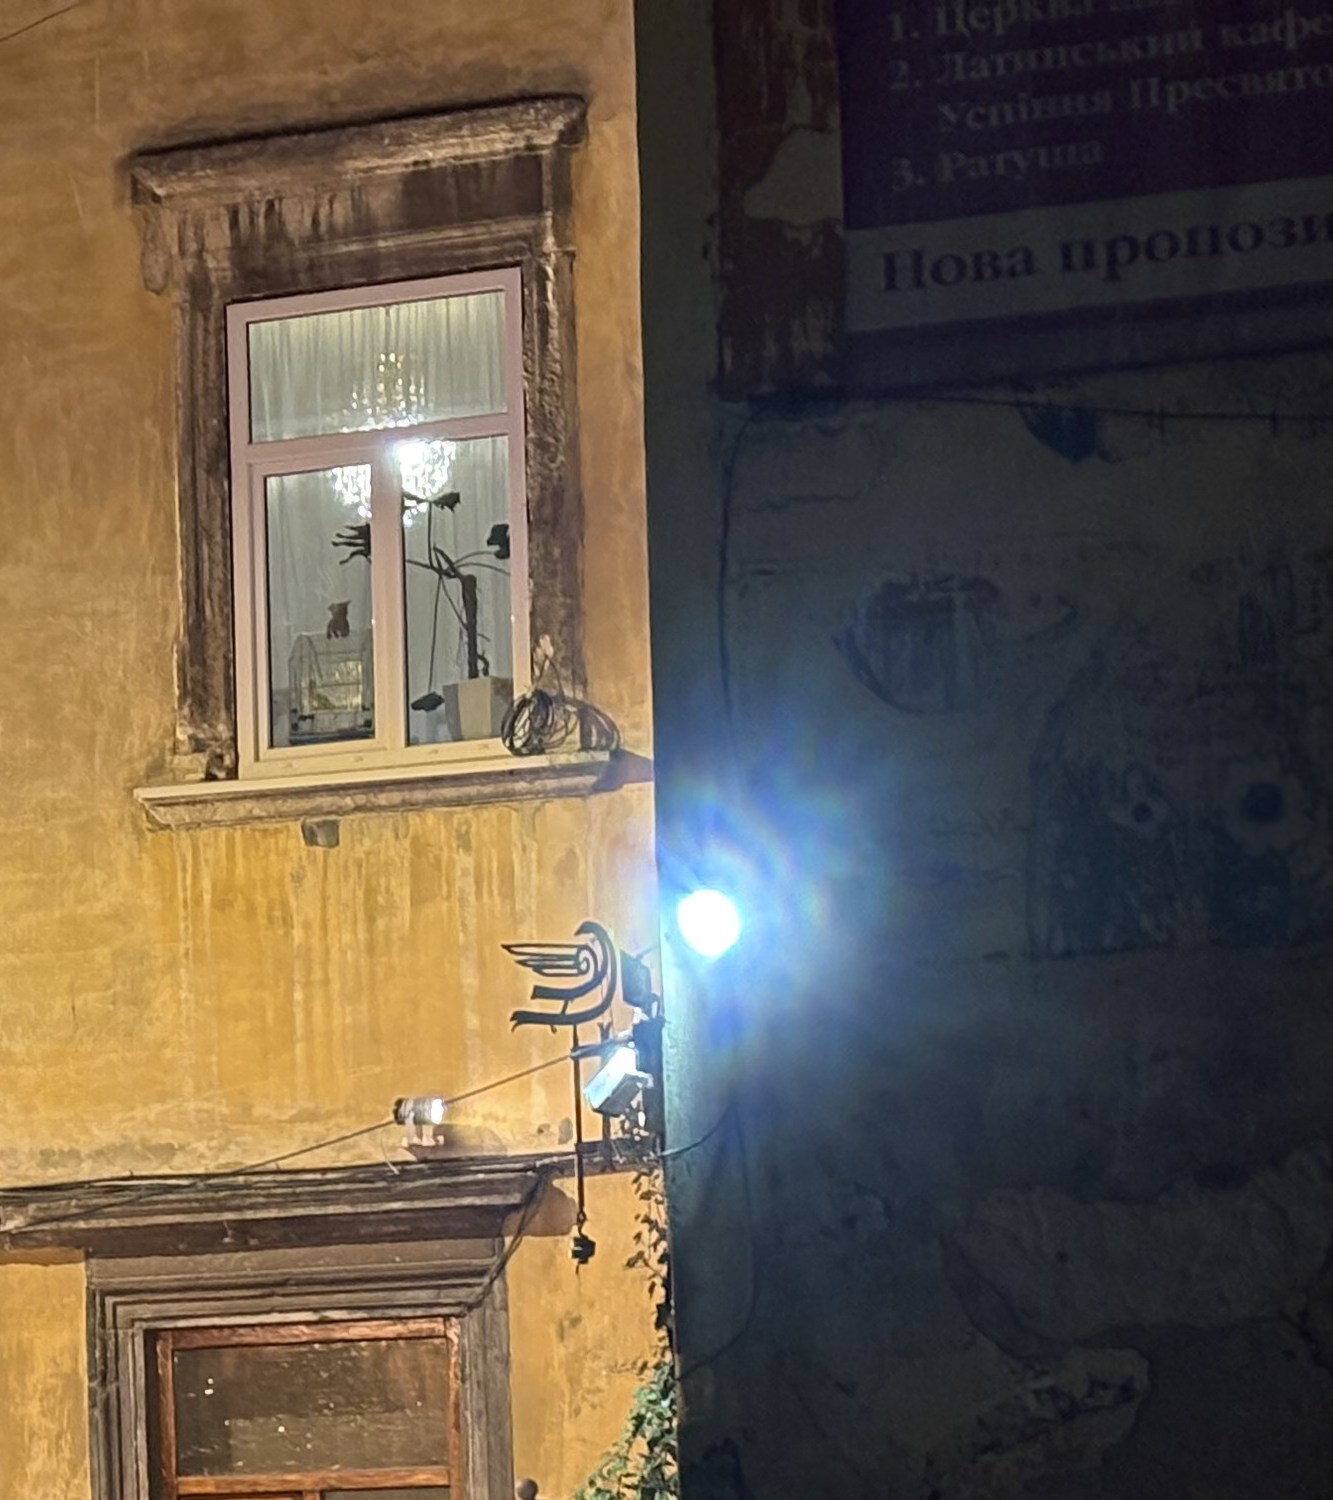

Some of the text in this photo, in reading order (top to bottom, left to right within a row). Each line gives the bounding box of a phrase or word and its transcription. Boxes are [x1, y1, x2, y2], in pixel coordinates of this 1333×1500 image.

[888, 11, 921, 41] 1.
[890, 59, 922, 90] 2.
[935, 20, 1203, 84] Латинський
[938, 90, 1112, 132] Успіння
[892, 140, 1104, 191] 3. Ратуша
[882, 212, 1333, 293] Нова пропози
